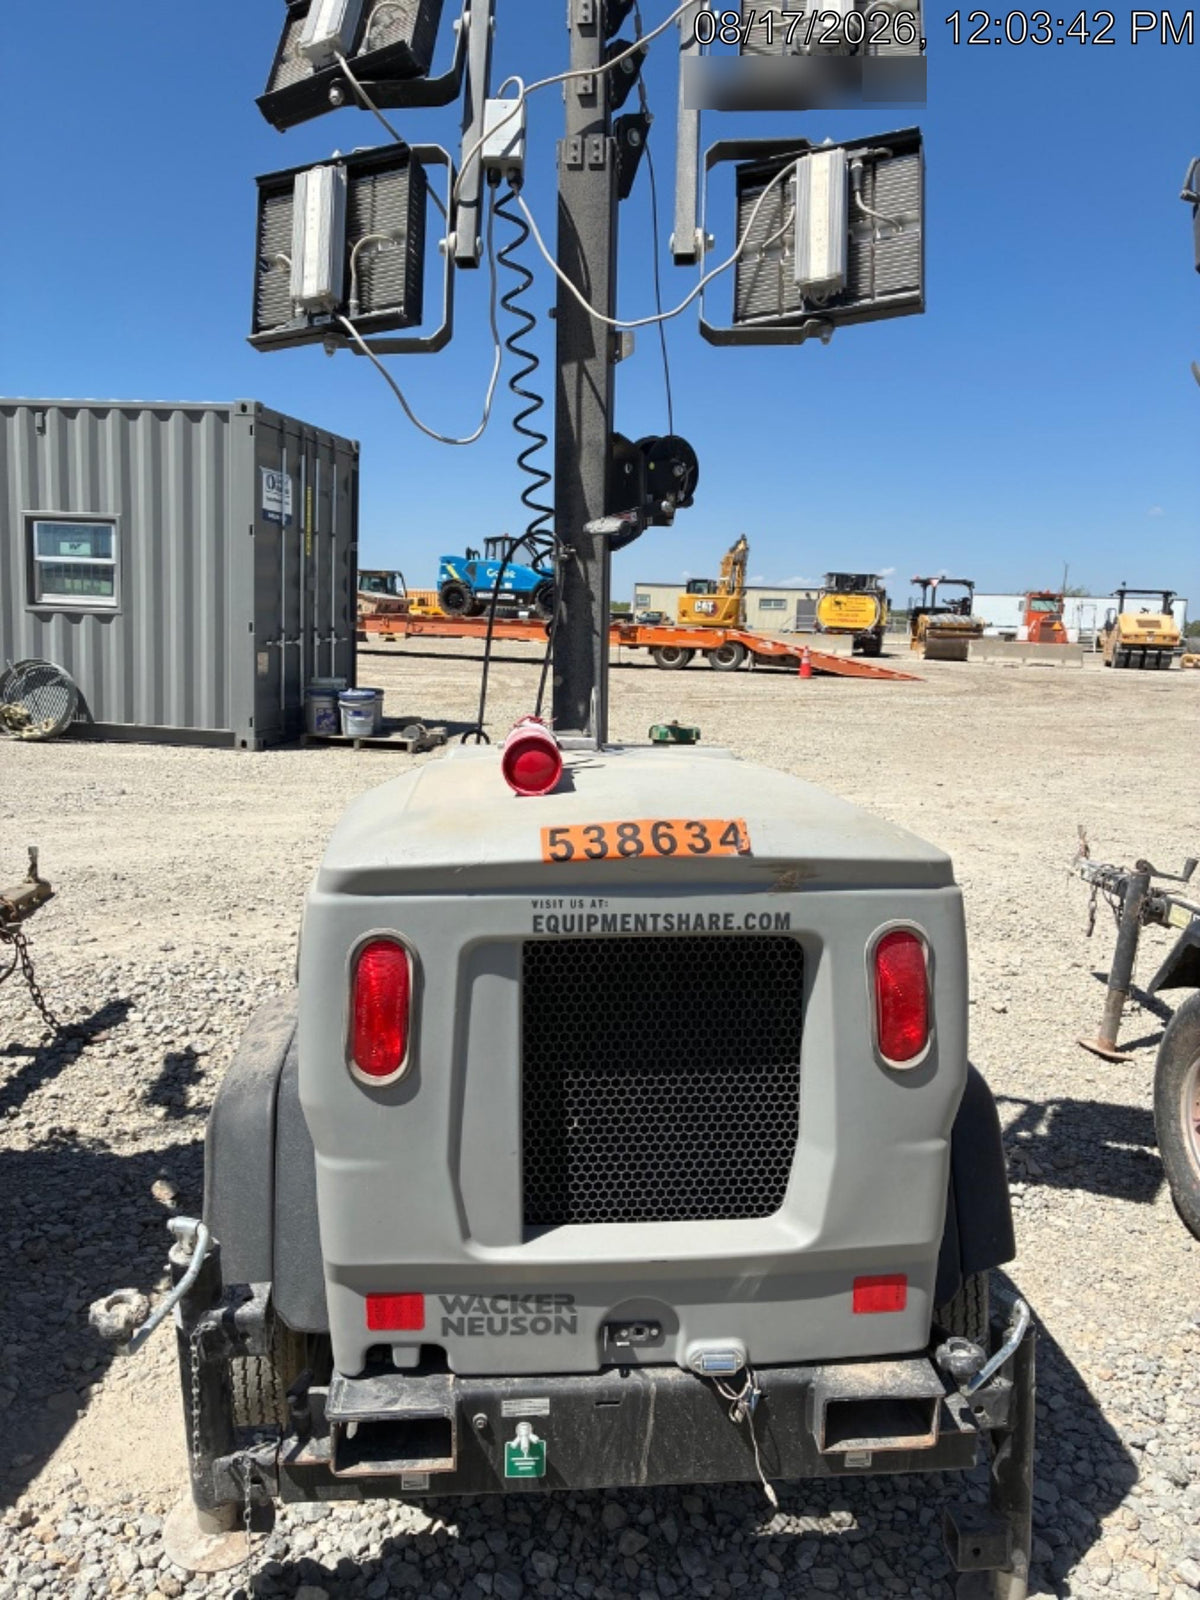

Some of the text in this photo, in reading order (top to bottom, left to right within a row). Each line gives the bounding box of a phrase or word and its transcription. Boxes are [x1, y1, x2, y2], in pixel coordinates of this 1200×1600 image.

[695, 600, 714, 613] CAT
[548, 821, 753, 862] 538634
[531, 899, 609, 909] VISIT US AT:
[532, 912, 791, 934] EQUIPMENTSHARE.COM
[438, 1294, 577, 1315] WACKER
[440, 1315, 577, 1337] NEUSON
